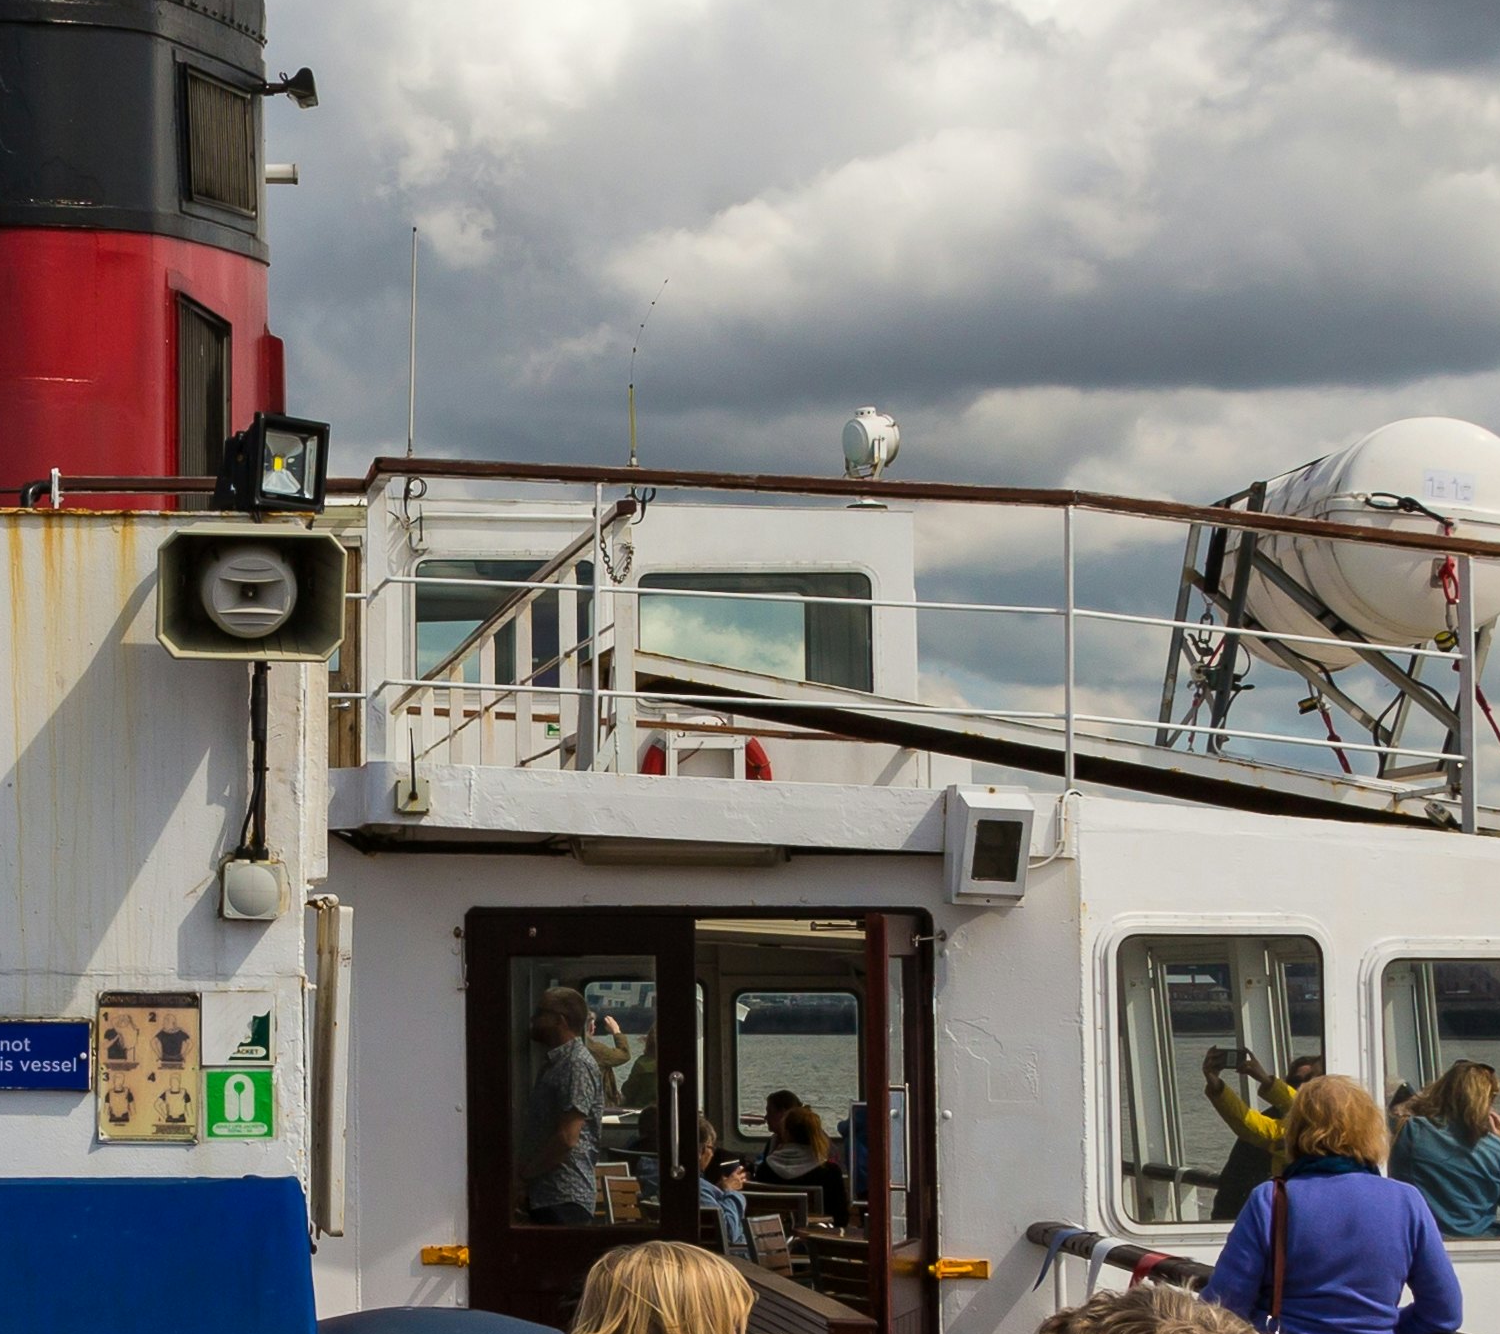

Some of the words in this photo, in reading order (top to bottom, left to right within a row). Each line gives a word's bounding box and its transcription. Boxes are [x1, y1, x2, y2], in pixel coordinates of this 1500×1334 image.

[102, 1012, 109, 1022] 1
[148, 1012, 157, 1023] 2
[0, 1037, 31, 1052] not
[20, 1057, 77, 1072] vessel
[102, 1072, 110, 1082] 3
[148, 1072, 157, 1083] 4
